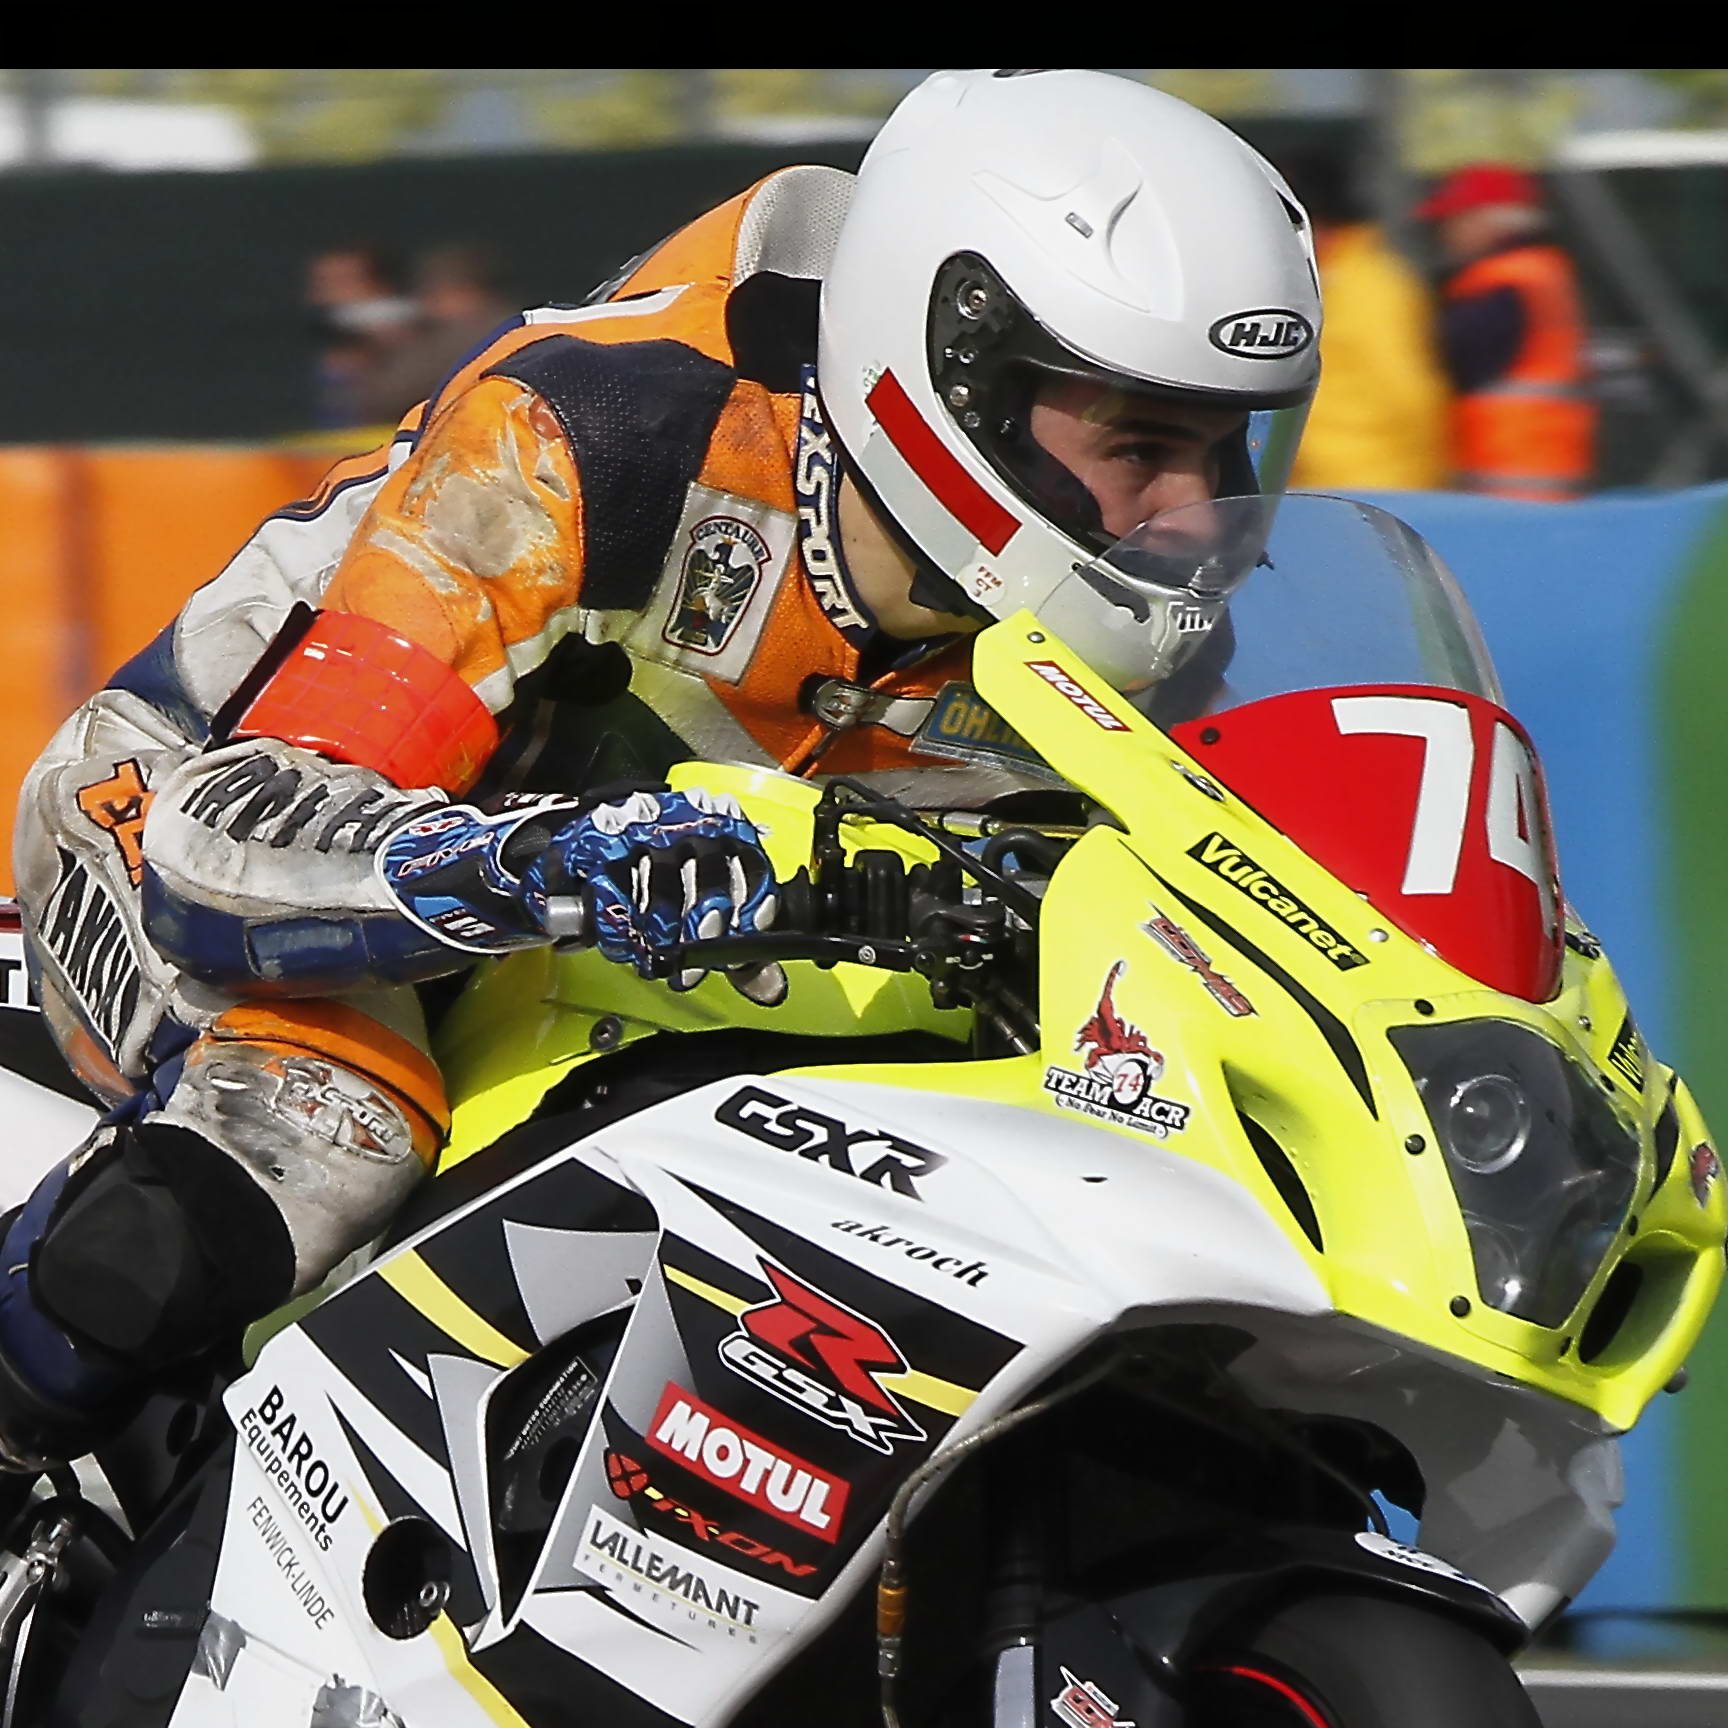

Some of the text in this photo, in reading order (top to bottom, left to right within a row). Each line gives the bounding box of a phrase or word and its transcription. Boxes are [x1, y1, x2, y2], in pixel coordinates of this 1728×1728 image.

[1229, 322, 1300, 347] HJC
[1029, 663, 1126, 730] MOTUL
[1330, 695, 1559, 942] 74
[1200, 834, 1358, 962] Vulcanet
[1046, 1067, 1186, 1127] TEAM ACR
[1114, 1072, 1144, 1094] 74
[714, 1084, 950, 1203] GSXR
[830, 1217, 991, 1289] akroch
[721, 1338, 899, 1443] GSX
[239, 1407, 334, 1553] Equipements
[257, 1384, 349, 1525] BAROU
[655, 1399, 832, 1530] MOTUL
[583, 1553, 758, 1645] FERMETURES
[589, 1520, 760, 1627] LALLEMANT
